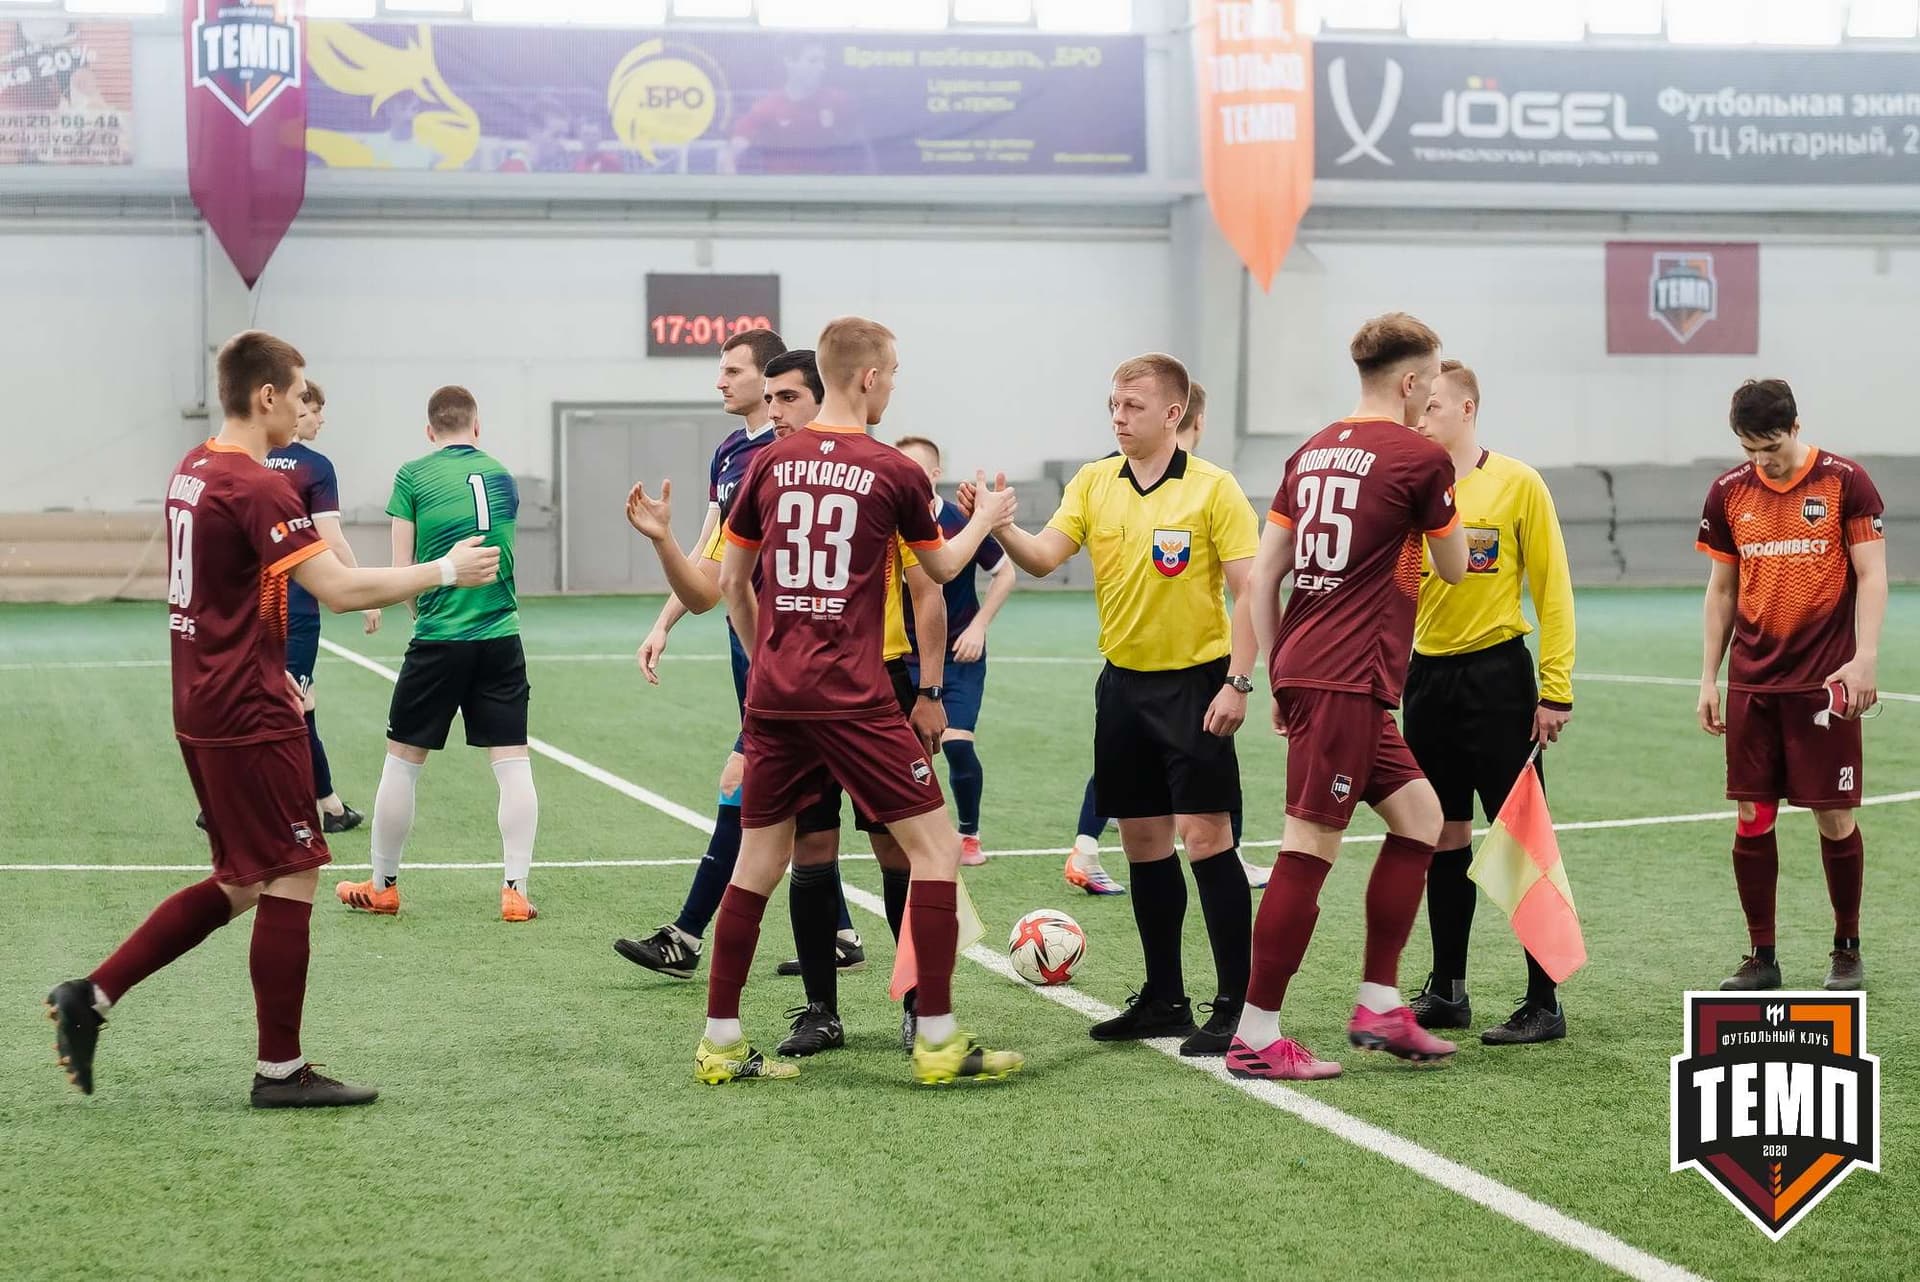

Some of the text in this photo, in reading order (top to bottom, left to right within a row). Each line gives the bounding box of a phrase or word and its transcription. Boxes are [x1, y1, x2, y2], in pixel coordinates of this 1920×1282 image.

[203, 23, 291, 73] ТЕМП
[1409, 75, 1659, 141] JÖGEL
[1657, 86, 1845, 122] Футбольная
[1689, 124, 1731, 160] ТЦ
[773, 460, 876, 496] ЧЕРКАСОВ
[467, 473, 491, 532] 1
[1295, 475, 1361, 572] 25
[775, 491, 858, 591] 33
[775, 595, 847, 614] SEUS
[1838, 766, 1854, 791] 23
